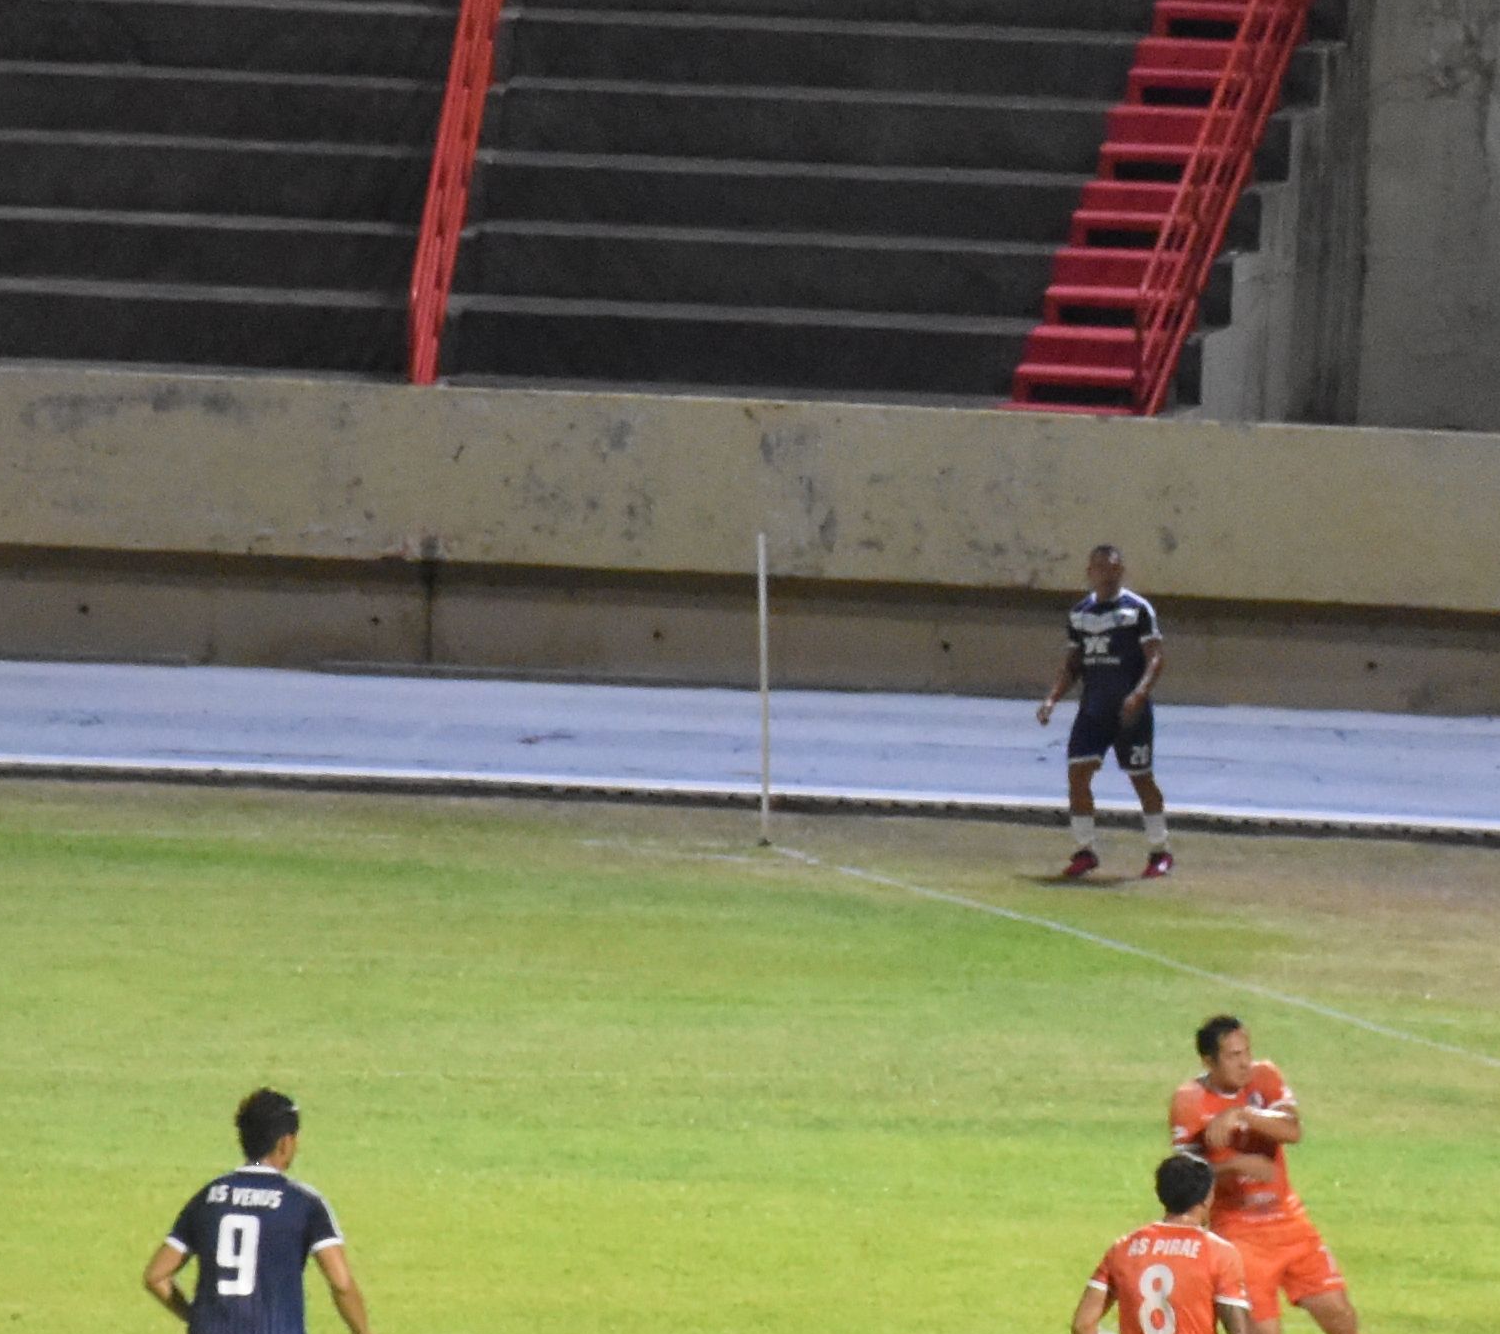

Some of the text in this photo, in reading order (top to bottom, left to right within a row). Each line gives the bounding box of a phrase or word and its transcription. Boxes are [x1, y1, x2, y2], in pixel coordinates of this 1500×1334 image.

[207, 1185, 284, 1209] AS VENUS
[216, 1213, 260, 1296] 9
[1127, 1237, 1202, 1259] AS PIRAE
